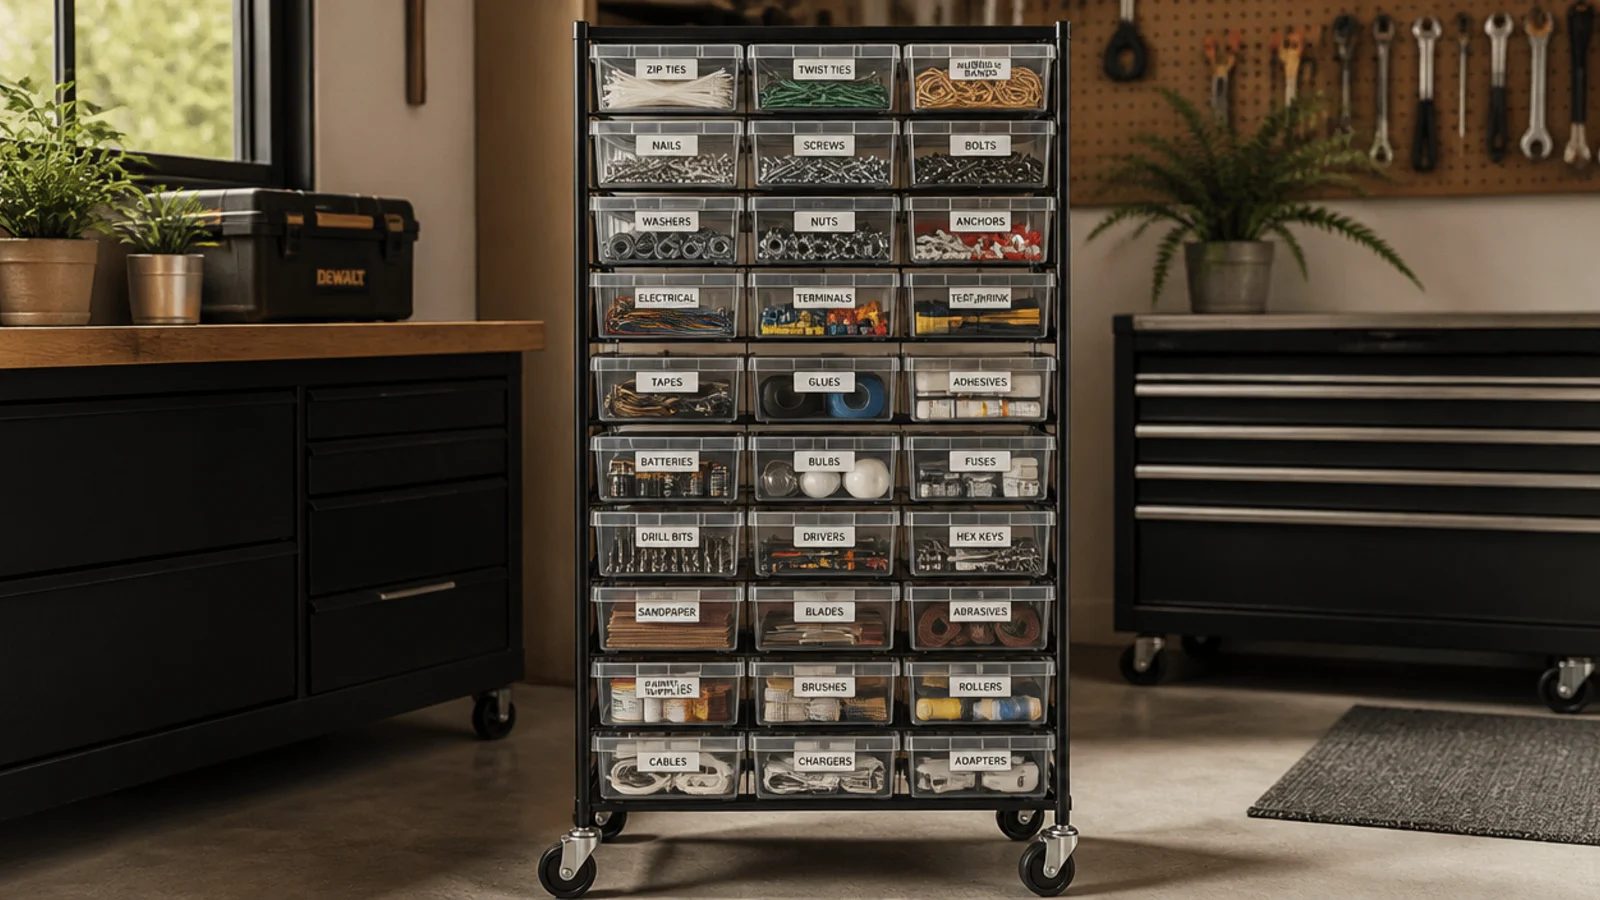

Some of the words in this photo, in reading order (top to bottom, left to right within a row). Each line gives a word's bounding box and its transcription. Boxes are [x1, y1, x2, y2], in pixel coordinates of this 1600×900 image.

[646, 64, 663, 75] ZIP
[665, 64, 687, 75] TIES
[798, 64, 829, 75] TWIST
[830, 64, 852, 75] TIES
[652, 140, 682, 151] NAILS
[803, 140, 846, 151] SCREWS
[964, 140, 997, 151] BOLTS
[641, 216, 692, 227] WASHERS
[810, 216, 839, 227] NUTS
[955, 216, 1006, 227] ANCHORS
[317, 269, 365, 286] DEWALT
[638, 293, 696, 303] ELECTRICAL
[796, 293, 853, 303] TERMINALS
[651, 377, 683, 387] TAPES
[808, 376, 841, 387] GLUES
[952, 377, 1008, 387] ADHESIVES
[640, 457, 694, 467] BATTERIES
[808, 456, 841, 467] BULBS
[964, 456, 997, 467] FUSES
[641, 531, 670, 542] DRILL
[671, 531, 694, 542] BITS
[803, 531, 846, 542] DRIVERS
[956, 531, 977, 542] HEX
[978, 531, 1004, 542] KEYS
[637, 607, 697, 617] SANDPAPER
[805, 606, 845, 617] BLADES
[952, 606, 1008, 617] ABRASIVES
[801, 682, 847, 692] BRUSHES
[958, 681, 1003, 692] ROLLERS
[648, 757, 688, 767] CABLES
[798, 756, 853, 767] CHARGERS
[954, 756, 1008, 766] ADAPTERS
